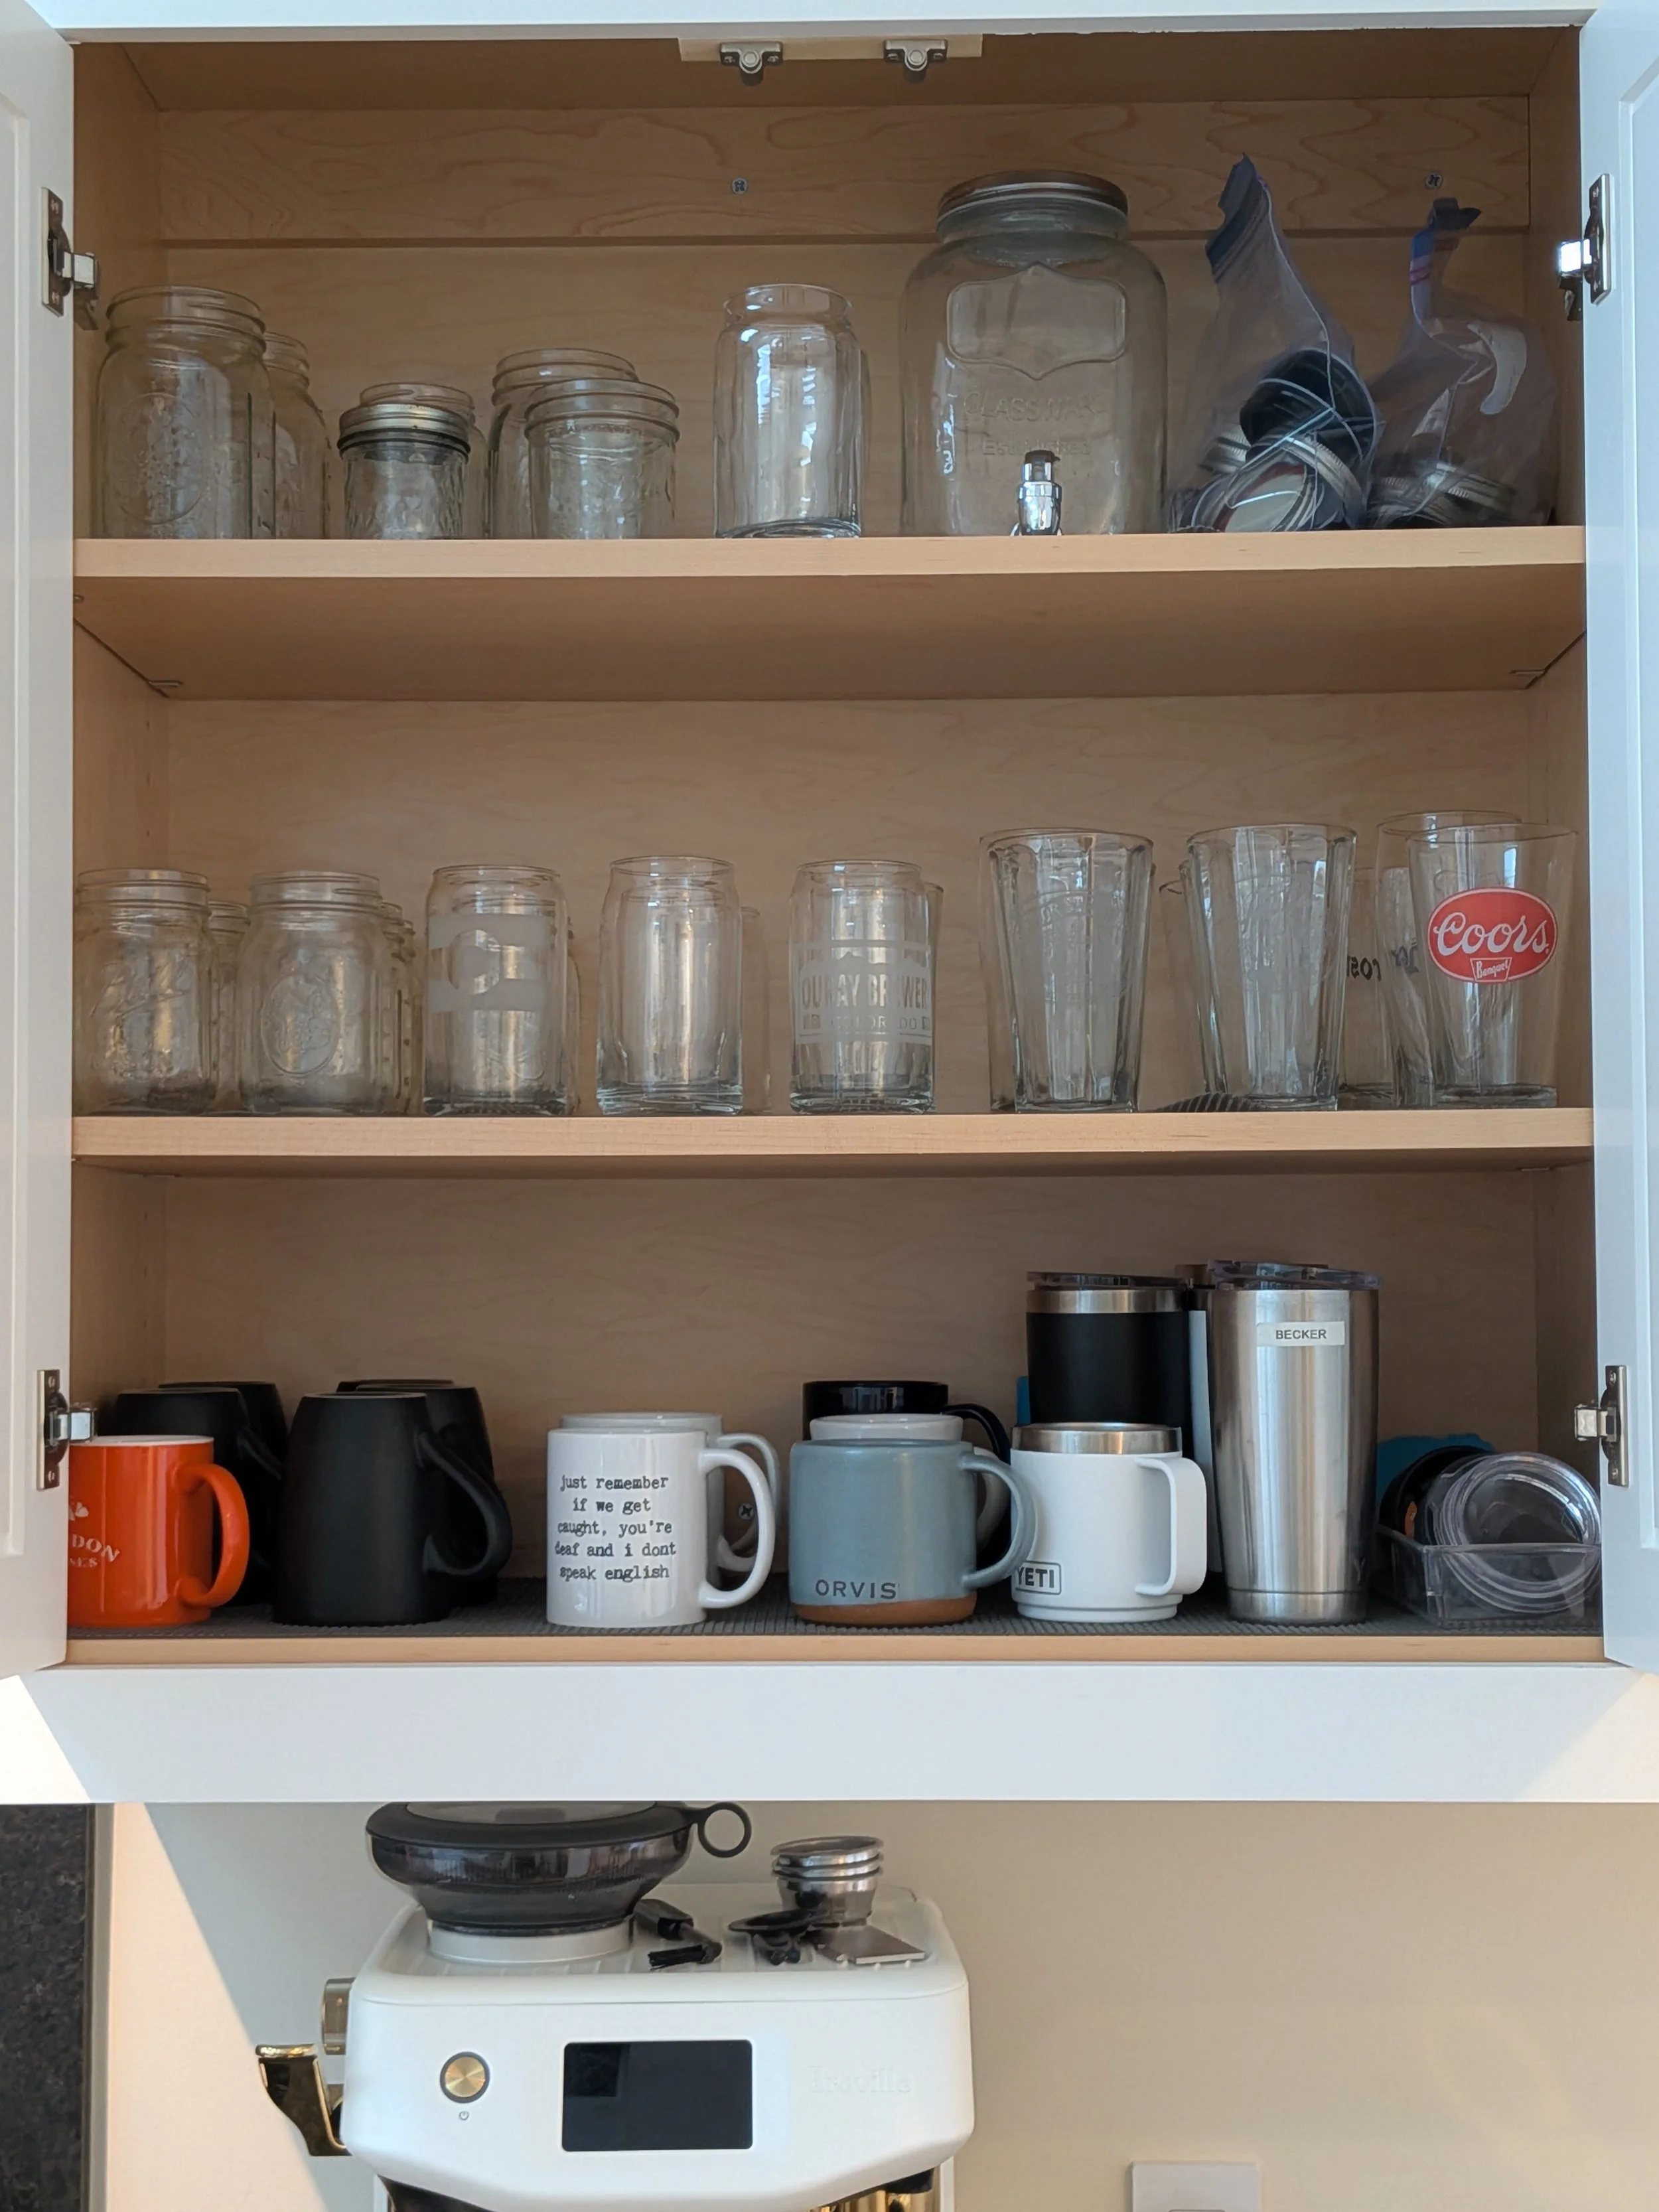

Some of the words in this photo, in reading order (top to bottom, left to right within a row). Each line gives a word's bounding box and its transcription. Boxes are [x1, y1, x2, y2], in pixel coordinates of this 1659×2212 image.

[1433, 912, 1549, 956] Coors
[1476, 959, 1508, 979] Banquet
[1275, 1329, 1327, 1339] BECKER
[560, 1475, 587, 1492] just
[596, 1475, 669, 1490] remember
[573, 1497, 588, 1512] if
[596, 1501, 614, 1512] we
[622, 1498, 651, 1515] get
[557, 1520, 607, 1537] caught,
[618, 1520, 672, 1538] you're
[555, 1541, 580, 1556] deaf
[587, 1543, 614, 1556] and
[624, 1543, 633, 1556] i
[642, 1542, 676, 1556] dont
[559, 1566, 597, 1582] speak
[605, 1564, 670, 1582] english
[1017, 1567, 1054, 1588] YETI
[816, 1580, 897, 1599] ORVIS
